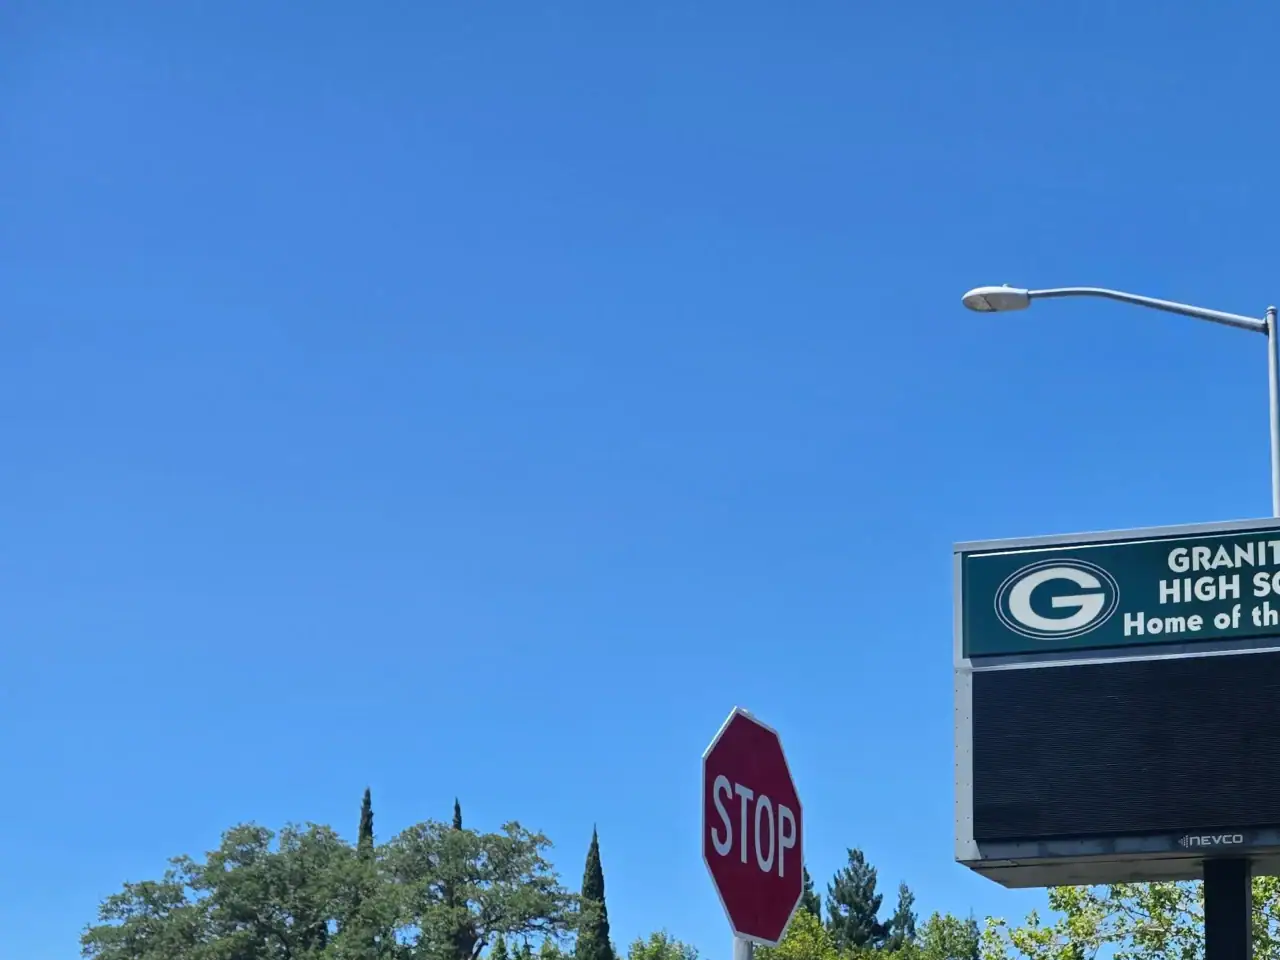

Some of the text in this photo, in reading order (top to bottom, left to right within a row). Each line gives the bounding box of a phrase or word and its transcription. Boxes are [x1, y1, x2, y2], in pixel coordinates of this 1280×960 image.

[1008, 567, 1105, 631] G
[1159, 573, 1241, 604] HIGH
[1123, 611, 1204, 637] Home
[1213, 603, 1242, 630] of
[710, 774, 797, 878] STOP
